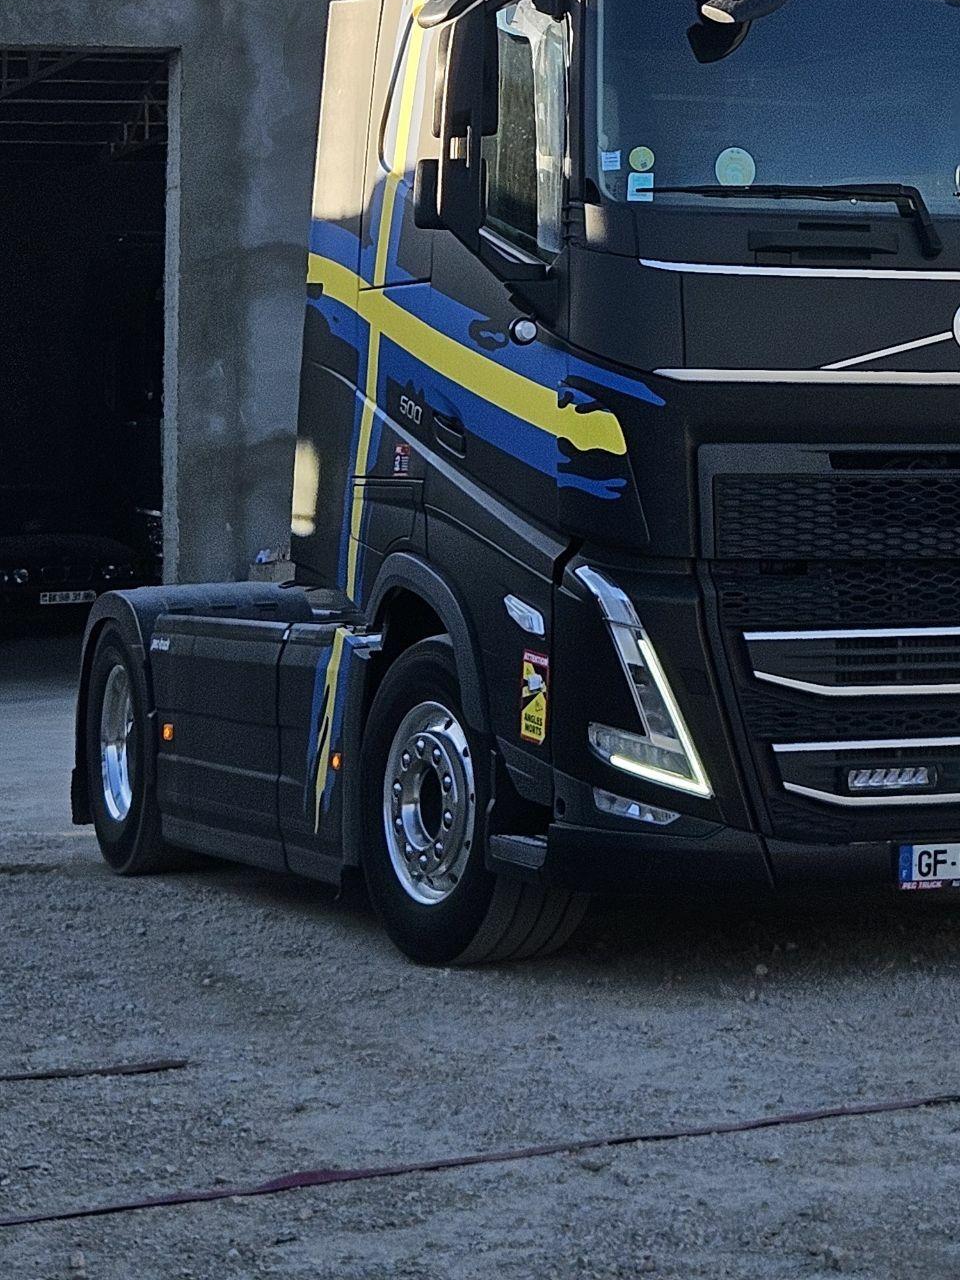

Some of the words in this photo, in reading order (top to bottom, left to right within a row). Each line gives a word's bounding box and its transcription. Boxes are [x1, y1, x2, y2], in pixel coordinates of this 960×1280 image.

[400, 395, 423, 425] 500
[524, 713, 542, 727] ANGLES
[524, 722, 542, 736] MORTS
